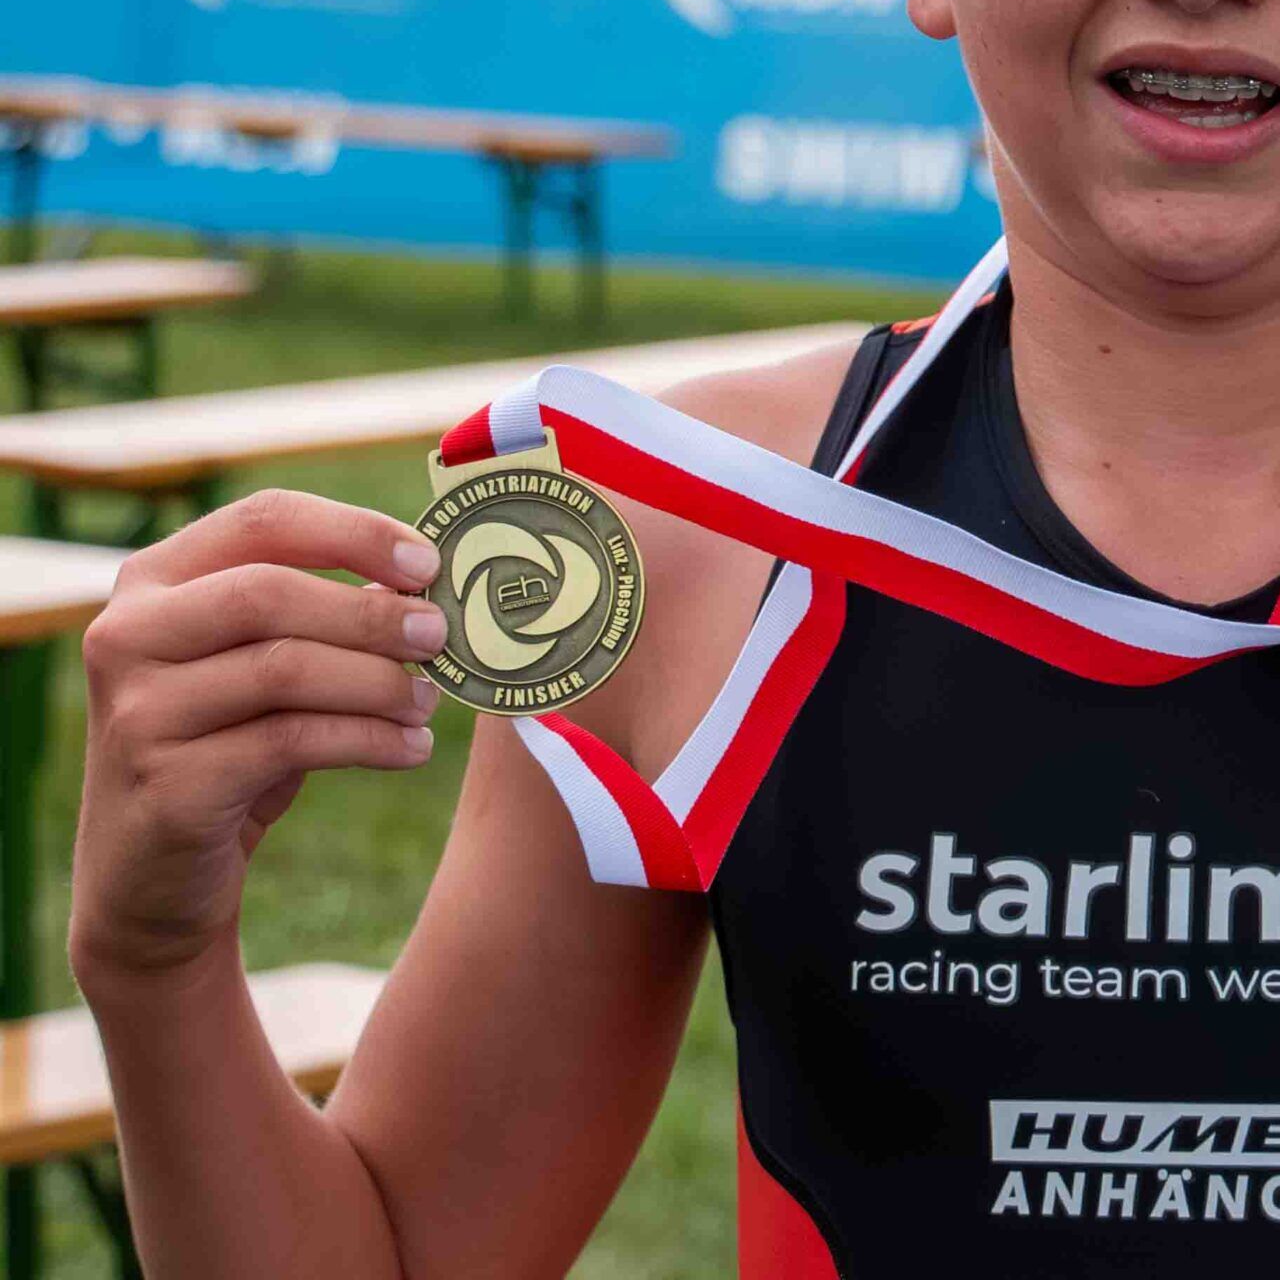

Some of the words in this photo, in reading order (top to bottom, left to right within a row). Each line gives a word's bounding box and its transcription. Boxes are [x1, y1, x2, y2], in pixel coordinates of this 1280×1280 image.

[458, 475, 594, 514] LINZTRIATHLON
[607, 534, 629, 565] Linz
[601, 575, 634, 650] Plesching
[493, 671, 586, 706] FINISHER
[851, 950, 1018, 1004] racing
[1040, 958, 1187, 999] team
